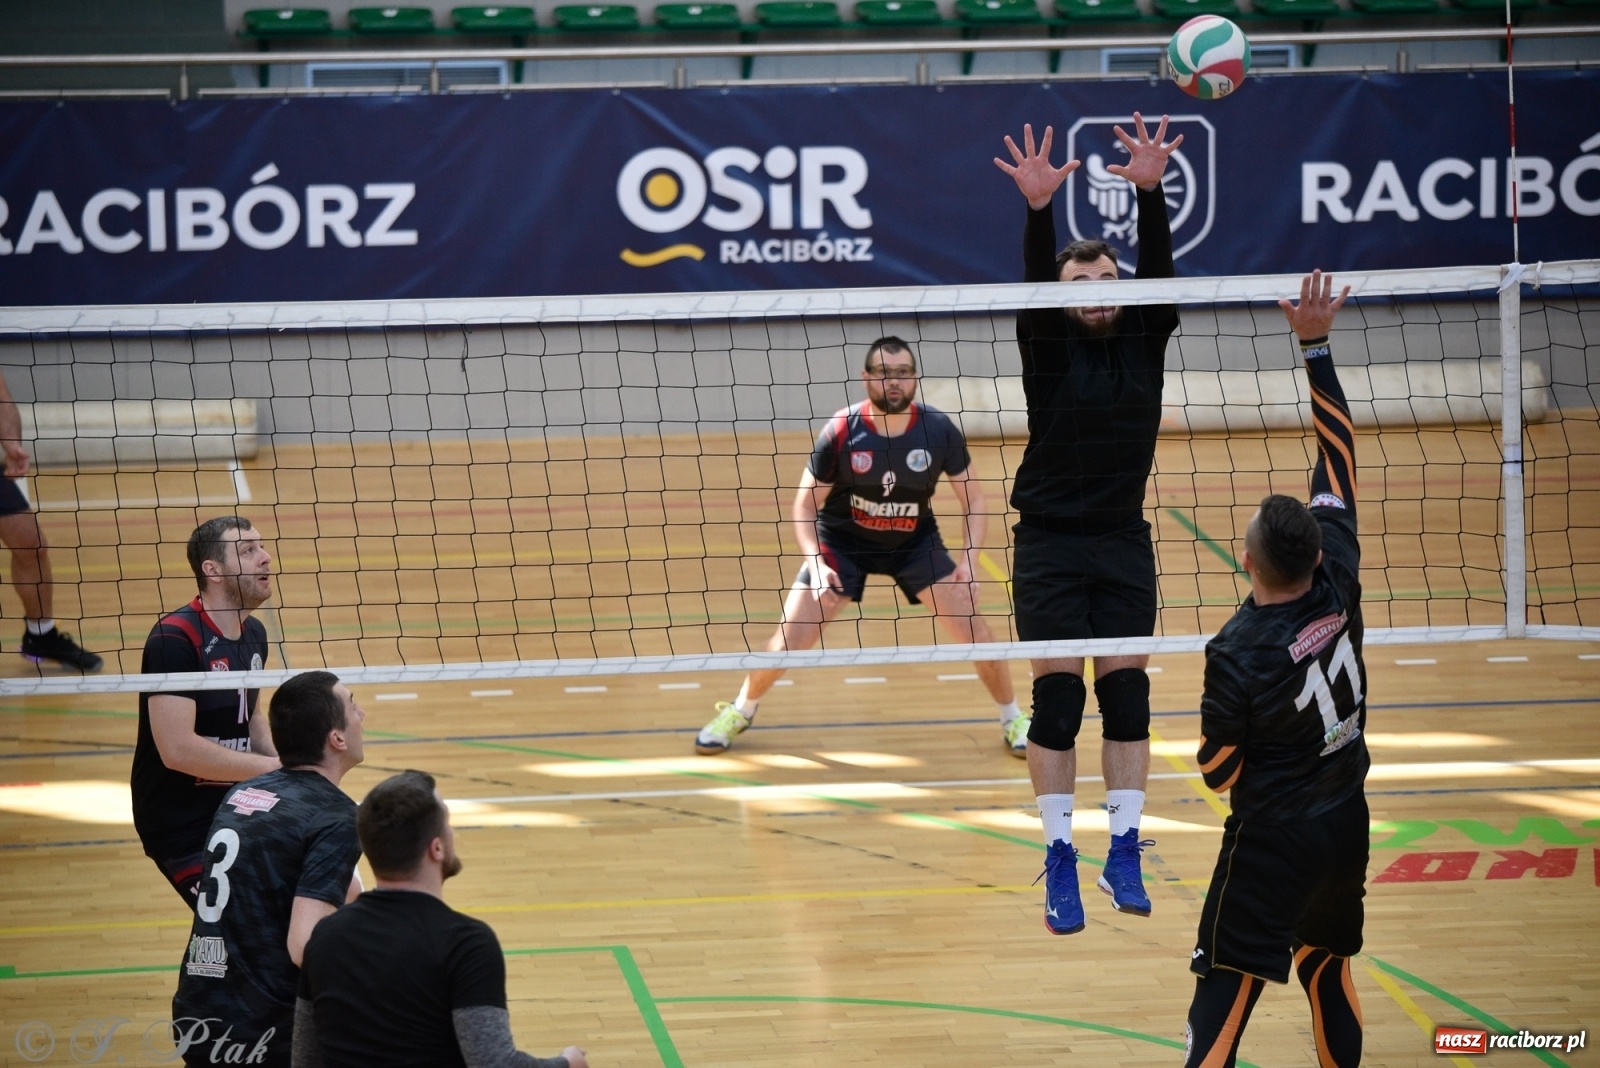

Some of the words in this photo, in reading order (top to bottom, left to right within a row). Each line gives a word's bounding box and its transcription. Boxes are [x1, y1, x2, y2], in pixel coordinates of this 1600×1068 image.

[0, 162, 418, 254] ACIBÓRZ
[719, 232, 873, 263] RACIBÓRZ
[881, 470, 897, 497] 9
[197, 828, 240, 923] 3
